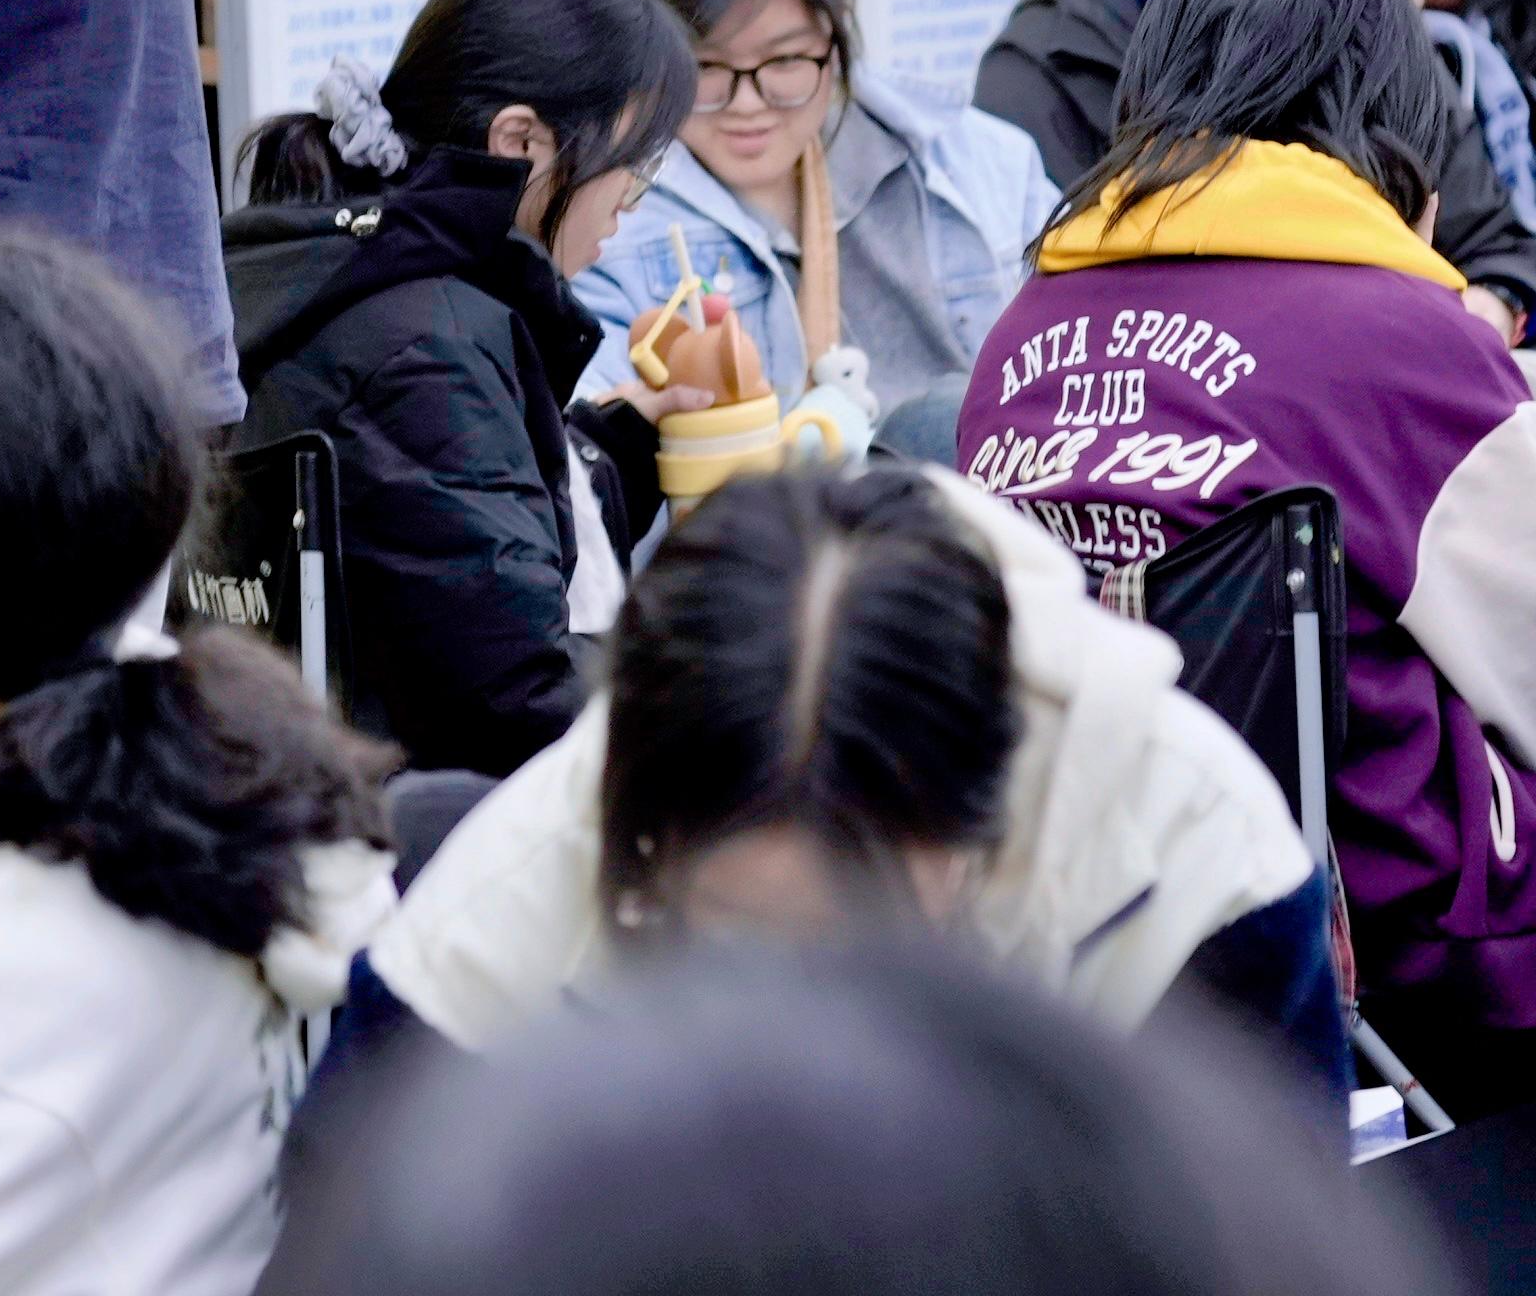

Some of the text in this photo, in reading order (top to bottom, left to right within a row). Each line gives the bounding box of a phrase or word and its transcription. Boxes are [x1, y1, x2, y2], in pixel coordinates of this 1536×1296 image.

[1000, 309, 1256, 405] ANTA SPORTS
[1054, 368, 1145, 427] CLUB
[1089, 431, 1258, 499] 1991
